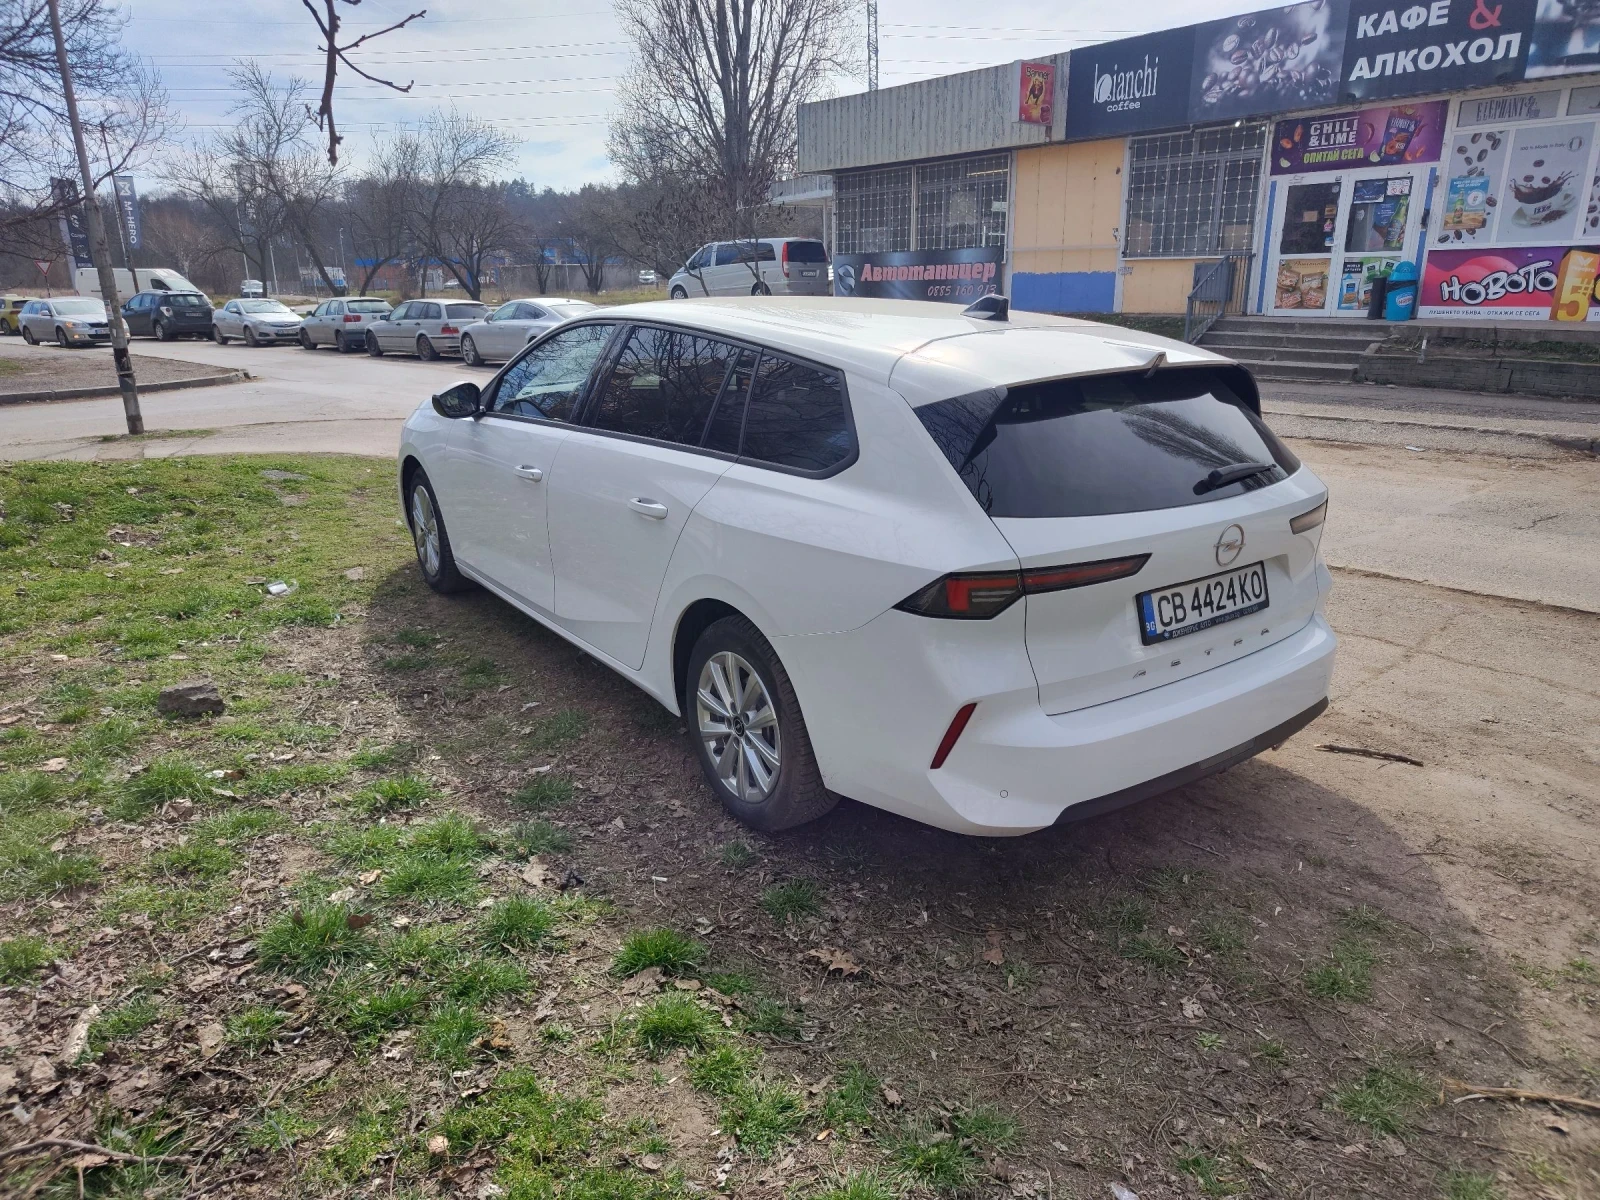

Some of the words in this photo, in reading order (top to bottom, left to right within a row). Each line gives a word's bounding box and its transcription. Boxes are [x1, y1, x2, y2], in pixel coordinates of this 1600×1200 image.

[1357, 0, 1450, 39] КАФЕ
[1469, 0, 1502, 30] &
[1348, 33, 1522, 81] АЛКОХОЛ
[1026, 66, 1050, 81] Banner
[1093, 54, 1159, 104] bianchi
[1106, 100, 1141, 112] coffee
[1310, 119, 1359, 136] CHILI
[1308, 131, 1357, 147] &LIME
[1303, 148, 1341, 164] ОПИТАЙ
[1341, 147, 1364, 160] СЕГА
[124, 201, 137, 244] M-HERO
[860, 261, 997, 282] Автотапицер
[927, 285, 951, 297] 0885
[955, 285, 974, 297] 160
[978, 284, 997, 295] 913
